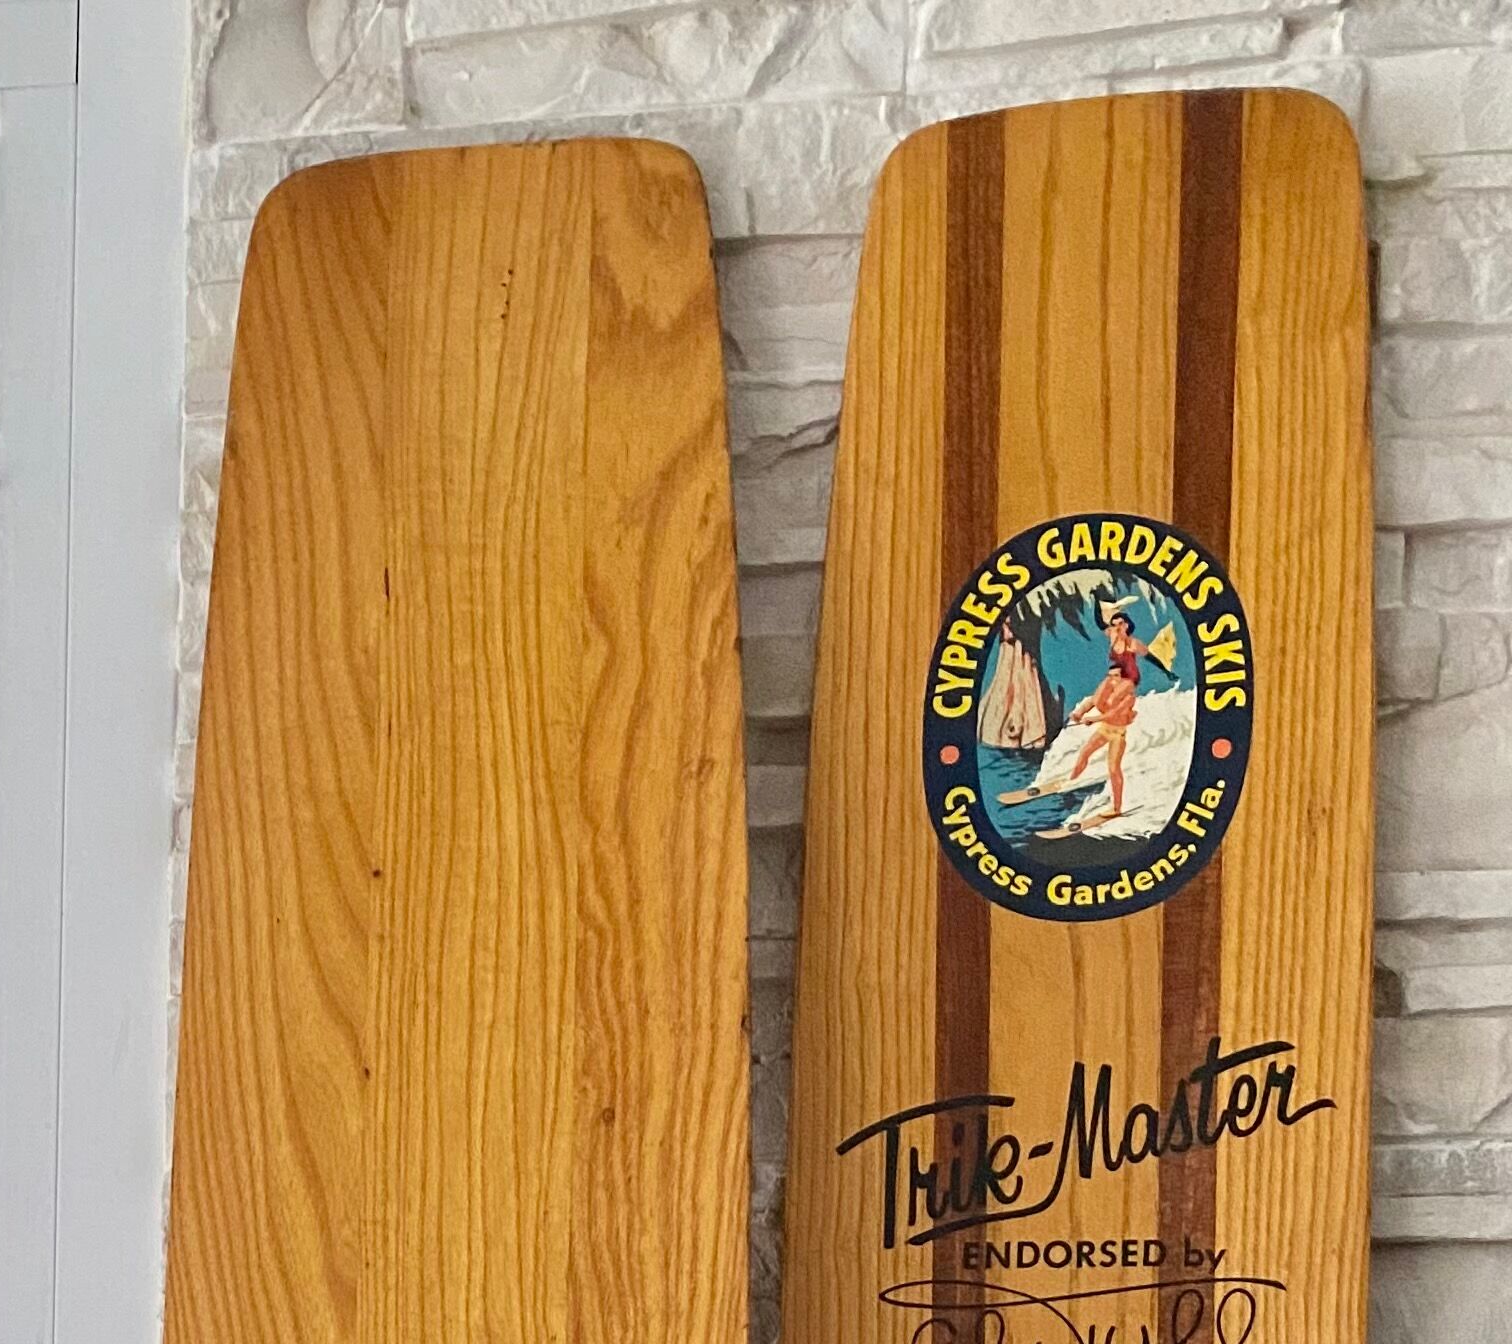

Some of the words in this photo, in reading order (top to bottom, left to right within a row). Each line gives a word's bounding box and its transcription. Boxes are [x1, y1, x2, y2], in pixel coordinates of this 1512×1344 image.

[933, 552, 1031, 718] CYPRESS
[1037, 521, 1224, 611] GARDENS
[1197, 613, 1247, 712] SKIS
[942, 786, 1032, 897] Cypress
[1046, 842, 1197, 906] Gardens,
[1178, 780, 1227, 836] Fla.
[963, 1239, 1167, 1269] ENDORSED
[1185, 1237, 1226, 1274] by
